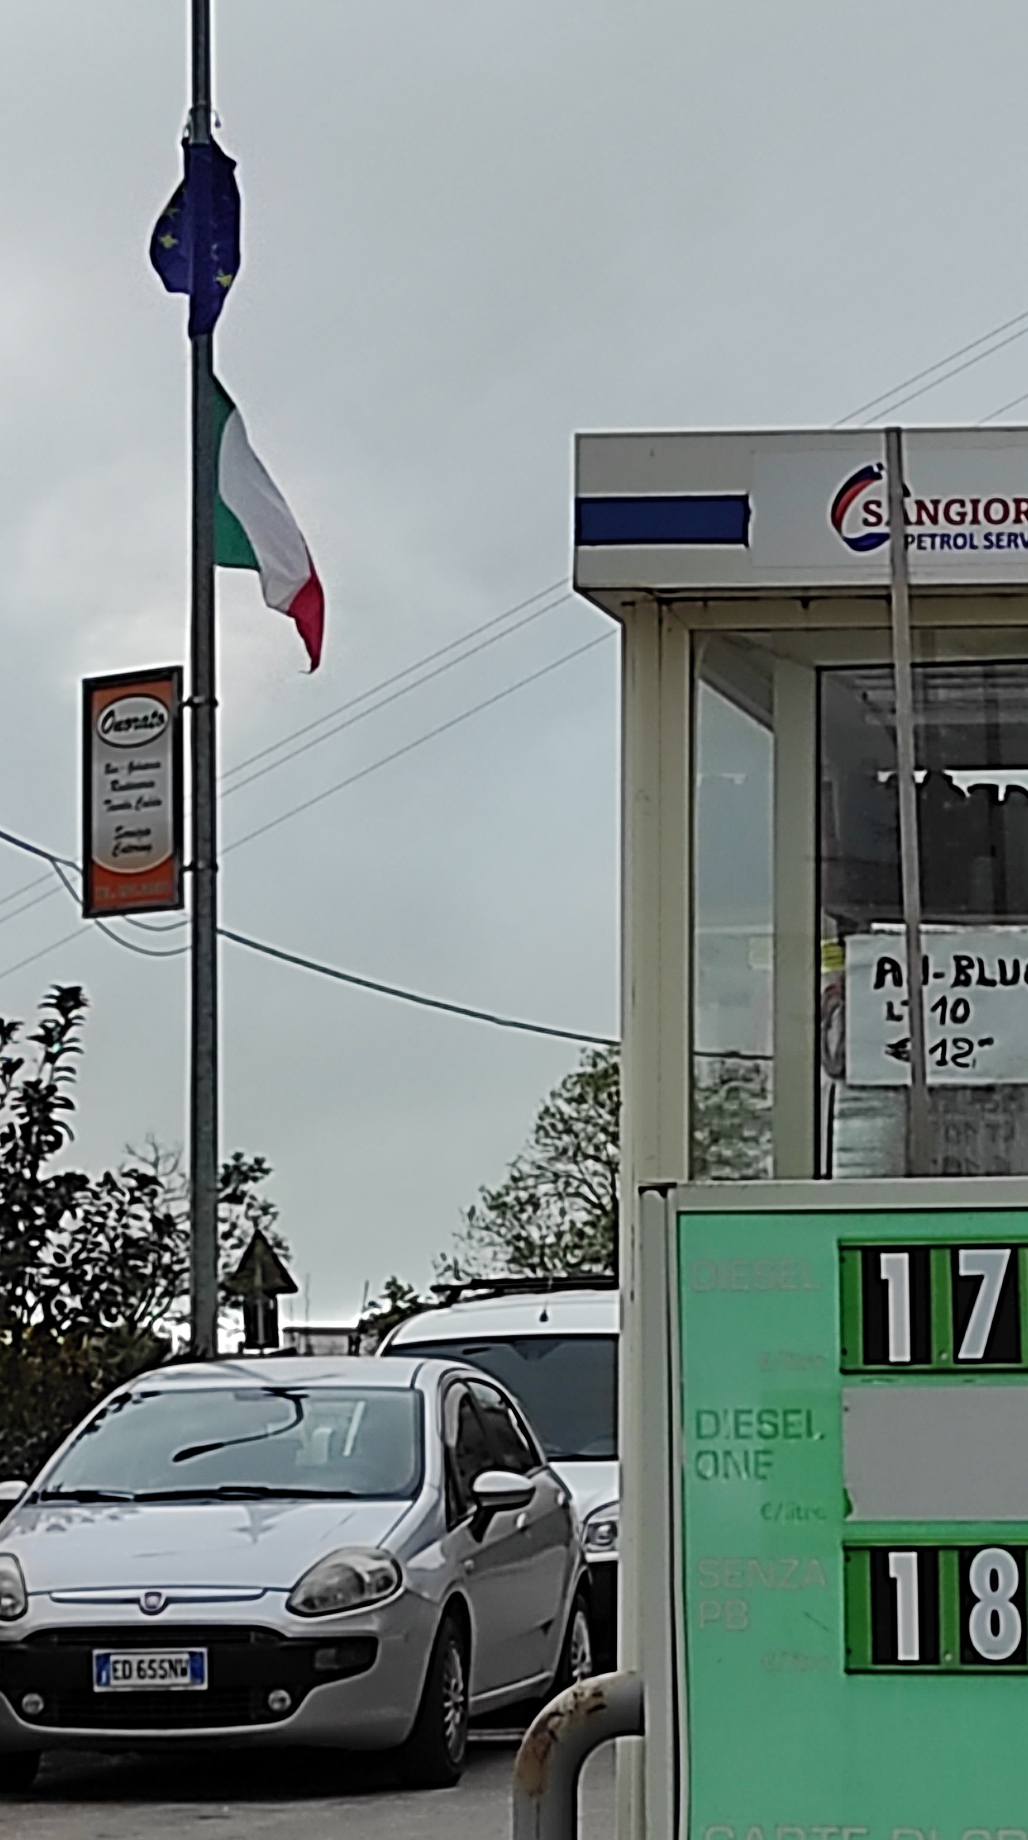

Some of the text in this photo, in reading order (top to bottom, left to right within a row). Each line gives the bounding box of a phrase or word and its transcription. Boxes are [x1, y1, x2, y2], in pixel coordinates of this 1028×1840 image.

[904, 532, 978, 550] PETROL
[930, 995, 970, 1025] 10
[691, 1257, 823, 1292] DIESEL
[696, 1409, 825, 1440] DIESEL
[695, 1449, 773, 1480] ONE
[696, 1557, 828, 1590] SENZA
[697, 1597, 750, 1631] PB
